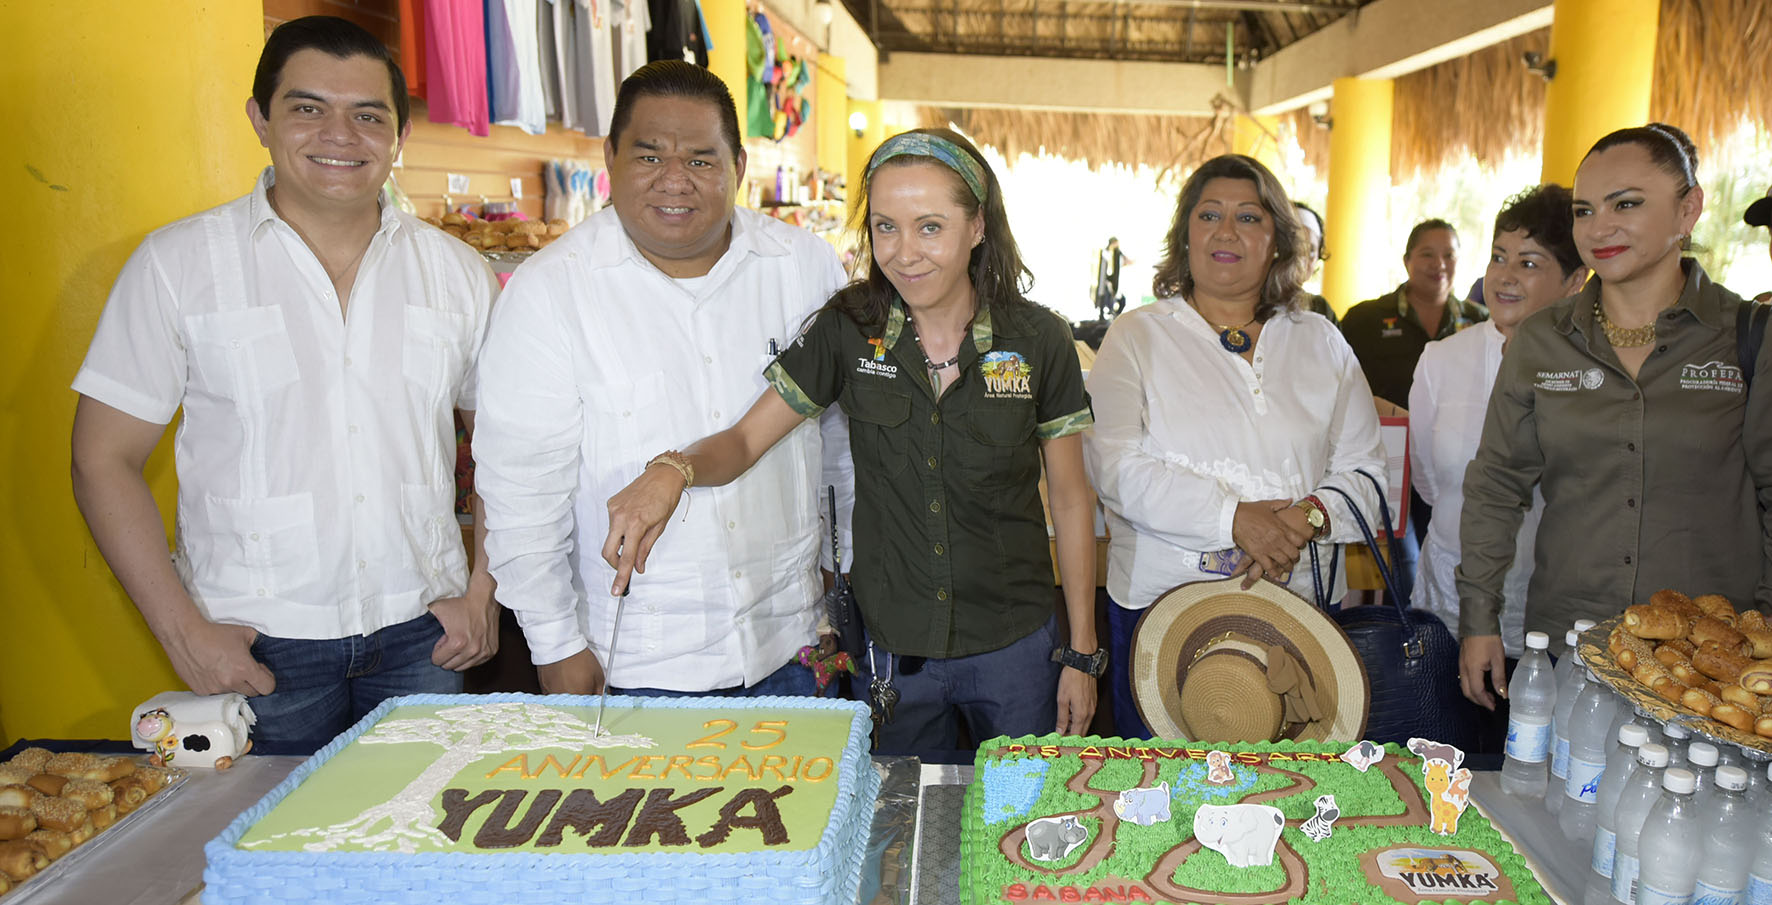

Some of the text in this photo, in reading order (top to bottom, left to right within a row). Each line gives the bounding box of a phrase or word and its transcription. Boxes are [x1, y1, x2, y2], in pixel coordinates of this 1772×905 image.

[856, 367, 897, 379] cambia contigo
[858, 358, 898, 373] Tabasco
[1536, 369, 1580, 378] SEMARNAT
[1681, 367, 1743, 381] PROFEPA
[686, 719, 788, 750] 25
[1008, 743, 1343, 765] 25 ANIVESARI
[485, 753, 834, 783] ANIVERSARIO
[437, 785, 794, 849] YUMKÁ
[1399, 872, 1497, 889] YUMKÁ
[1007, 883, 1152, 902] SABANA
